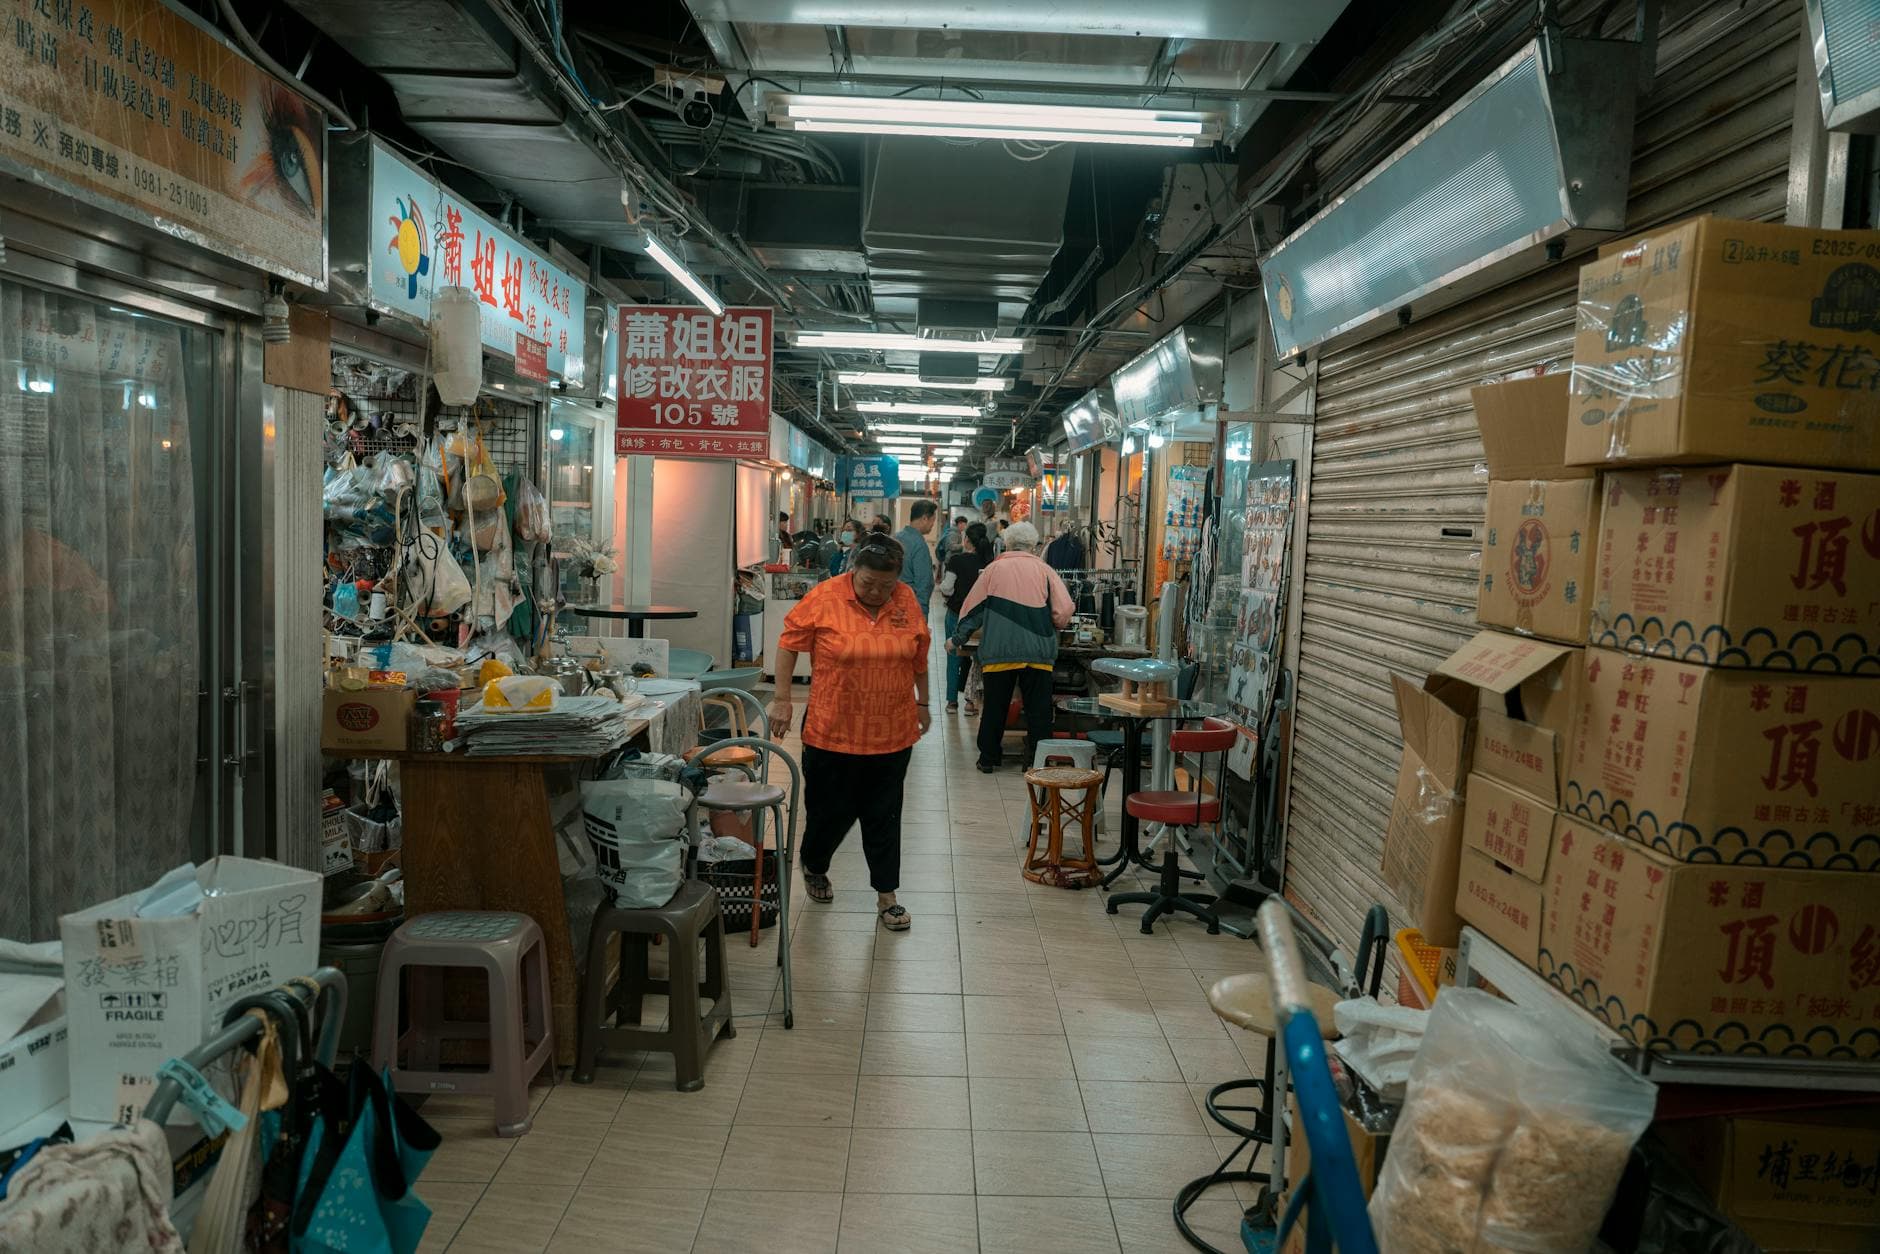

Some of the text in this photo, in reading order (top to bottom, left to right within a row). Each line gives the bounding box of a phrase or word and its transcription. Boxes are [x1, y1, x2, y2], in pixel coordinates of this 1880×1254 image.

[625, 312, 766, 361] 蕭姐姐
[1753, 338, 1880, 391] 葵花
[623, 363, 766, 402] 修改衣服
[650, 403, 739, 426] 105 號
[1779, 479, 1838, 511] 米酒
[1791, 516, 1854, 598] 頂
[1749, 684, 1809, 714] 米酒
[1759, 719, 1825, 799] 頂
[1708, 880, 1767, 910] 米酒
[1717, 914, 1781, 991] 頂
[75, 953, 180, 991] 發票箱
[228, 969, 271, 992] FAMA
[105, 1009, 165, 1022] FRAGILE
[1710, 993, 1880, 1022] 遵照古法「純米」
